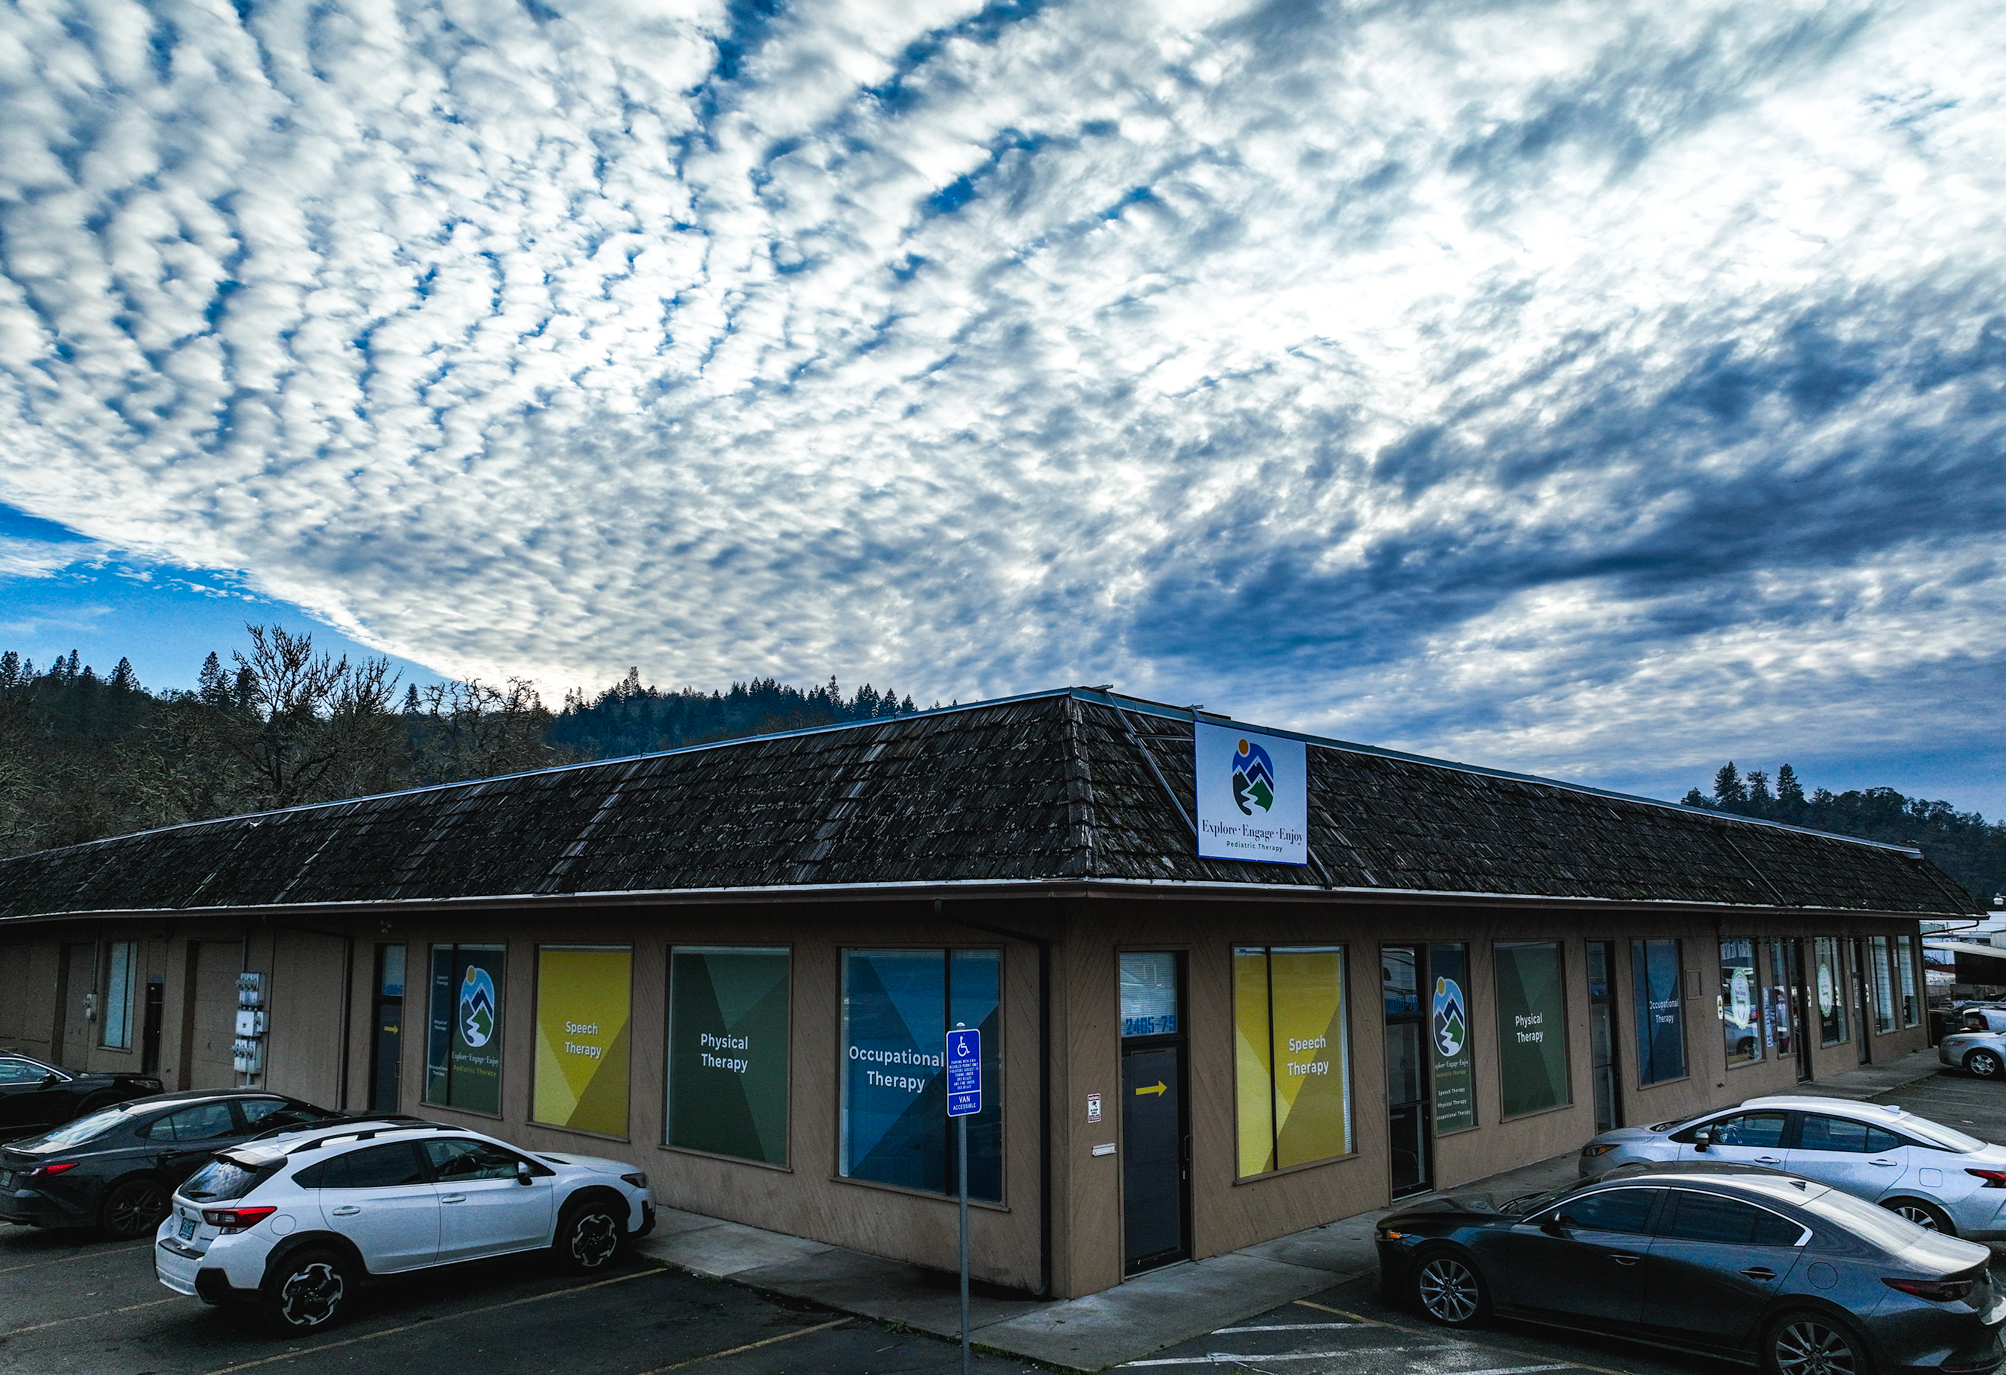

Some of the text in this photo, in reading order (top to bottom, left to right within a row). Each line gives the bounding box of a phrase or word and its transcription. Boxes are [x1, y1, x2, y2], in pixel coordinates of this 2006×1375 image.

[1202, 819, 1303, 846] Explore Engage Enjoy
[1226, 840, 1283, 853] Pediatric Therapy
[1515, 1013, 1543, 1028] Physical
[1655, 1014, 1674, 1024] Therapy
[565, 1020, 598, 1036] Speech
[700, 1033, 748, 1050] Physical
[1288, 1035, 1326, 1054] Speech
[1516, 1030, 1543, 1043] Therapy
[565, 1041, 602, 1059] Therapy
[849, 1045, 945, 1067] Occupational
[701, 1053, 748, 1073] Therapy
[1287, 1061, 1329, 1076] Therapy
[867, 1070, 925, 1094] Therapy
[953, 1102, 976, 1111] ACCESSIBLE
[958, 1095, 971, 1104] VAN
